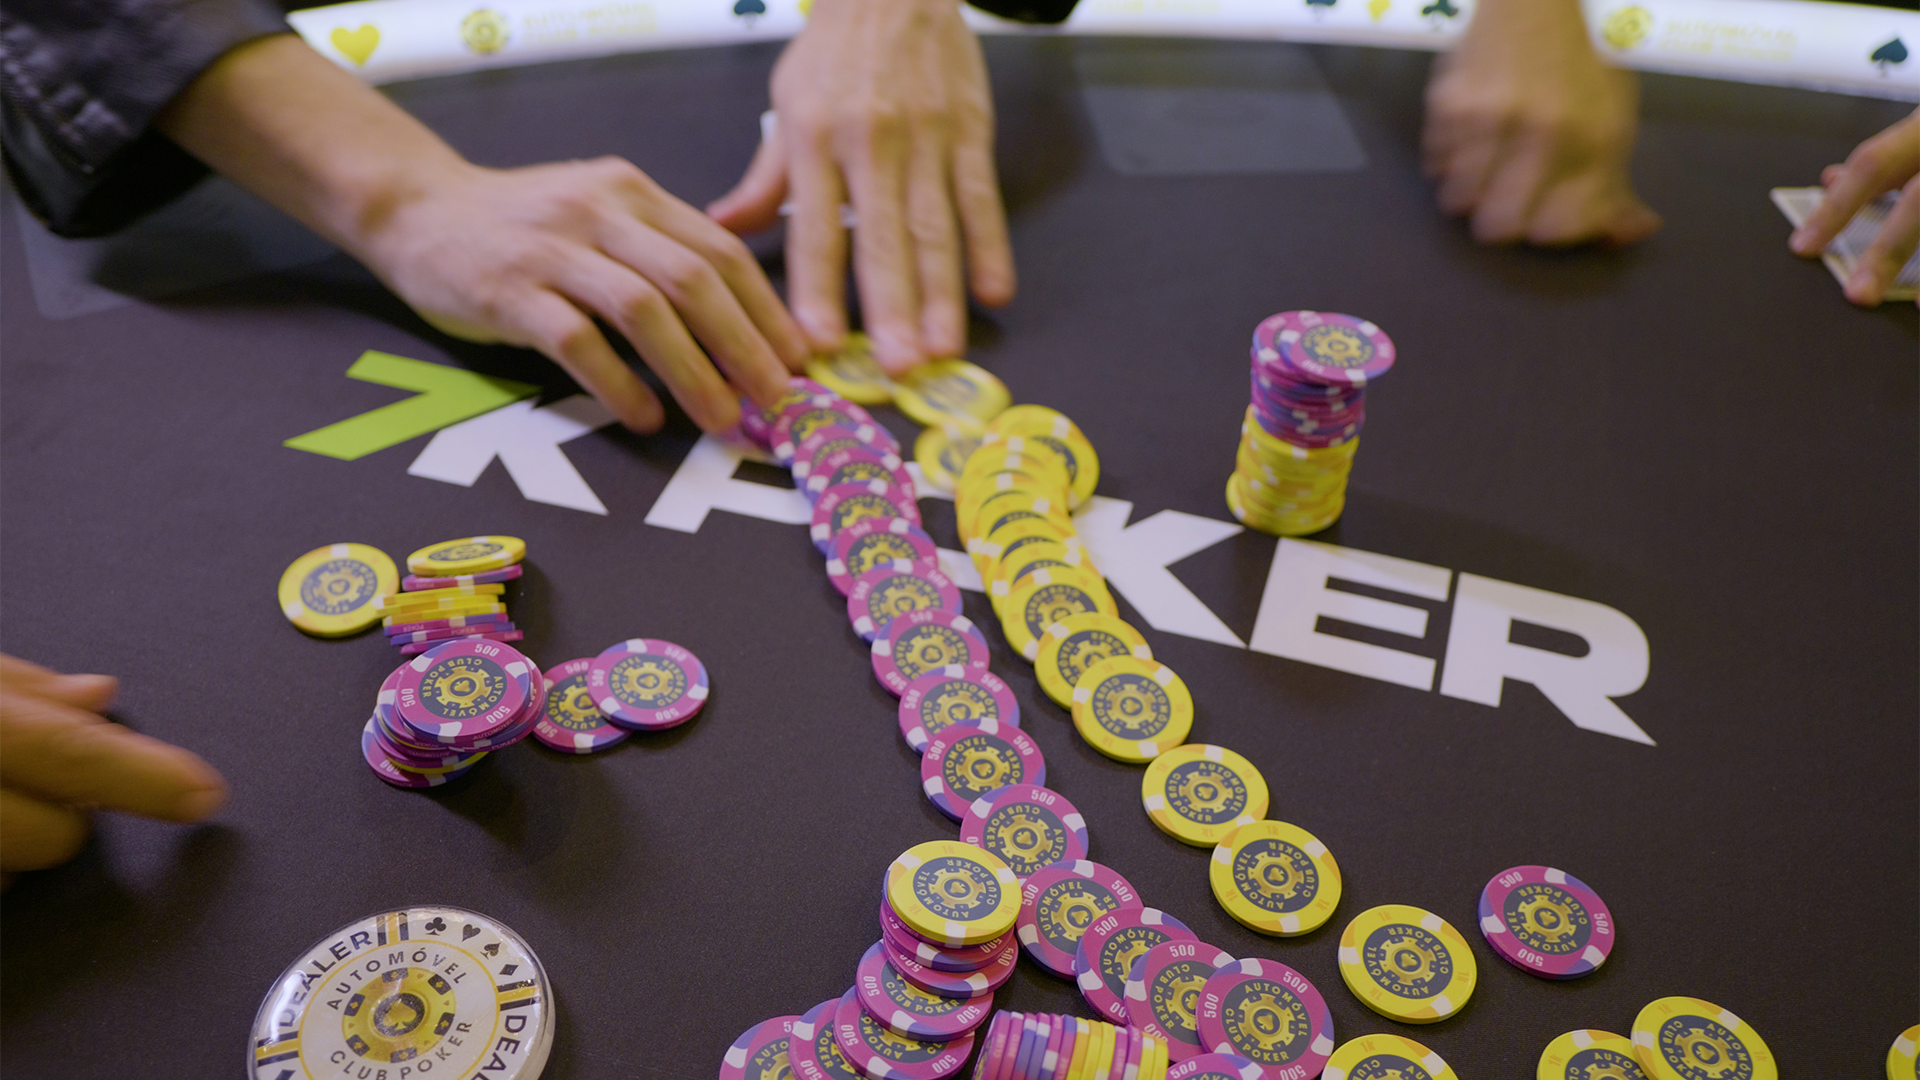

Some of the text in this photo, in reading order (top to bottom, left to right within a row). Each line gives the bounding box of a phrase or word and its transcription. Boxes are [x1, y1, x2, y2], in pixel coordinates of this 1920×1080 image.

[643, 432, 1657, 747] PKER
[474, 643, 500, 657] 500
[664, 646, 688, 662] 500
[422, 657, 482, 698] CLUB POKER
[565, 661, 589, 674] 500
[981, 674, 1003, 692] 500
[401, 688, 416, 708] 500
[443, 676, 504, 717] AUTOMÓVEL
[904, 689, 921, 709] 500
[944, 682, 997, 719] AUTOMÓVE
[486, 705, 511, 724] 500
[655, 707, 680, 721] 500
[537, 721, 558, 738] 500
[927, 740, 947, 761] 500
[1013, 735, 1034, 756] 500
[1031, 789, 1056, 806] 500
[1007, 804, 1040, 815] CLUB
[987, 812, 1006, 849] POKER
[1235, 852, 1284, 910] AUTOMÓVEL
[1268, 842, 1315, 898] CLUB POKER
[1499, 871, 1523, 888] 500
[946, 859, 998, 906] CLUB POKER
[1111, 880, 1133, 902] 500
[917, 871, 970, 919] AUTOMÓVEL
[1022, 883, 1039, 907] 500
[1518, 885, 1588, 925] CLUB POKER
[1040, 881, 1083, 939] AUTOMÓVEL
[1094, 916, 1118, 936] 500
[1507, 911, 1577, 953] AUTOMÓVEL
[1593, 912, 1610, 935] 500
[998, 947, 1014, 967] 500
[1103, 929, 1161, 975] AUTOMÓVEL
[1169, 944, 1195, 958] 500
[1387, 927, 1449, 974] CLUB POKER
[1517, 948, 1544, 967] 500
[277, 930, 373, 1028] DEALER
[327, 947, 468, 1010] AUTOMÓVEL
[1283, 971, 1308, 994] 500
[1367, 946, 1429, 996] AUTOMÓVEL
[863, 976, 880, 997] 500
[886, 982, 960, 1014] CLUB POKER
[1154, 963, 1190, 1030] CLUB POKER
[956, 1005, 981, 1024] 500
[1109, 1002, 1127, 1018] 00
[1204, 993, 1219, 1018] 500
[1244, 983, 1308, 1036] AUTOMÓVEL
[841, 1024, 859, 1046] 500
[861, 1016, 903, 1060] AUTOMÓ
[1225, 1008, 1290, 1062] CLUB POKER
[1663, 1021, 1683, 1044] CLUB
[330, 1020, 473, 1080] CLUB POKER
[471, 1014, 527, 1080] DEAL
[819, 1030, 834, 1068] POKER
[927, 1042, 943, 1055] CL
[1706, 1023, 1751, 1080] AUTOMÓV
[800, 1059, 823, 1080] 500
[932, 1054, 957, 1074] 500
[1170, 1060, 1197, 1079] 500
[1280, 1064, 1307, 1080] 500
[1594, 1052, 1645, 1078] AUTOM
